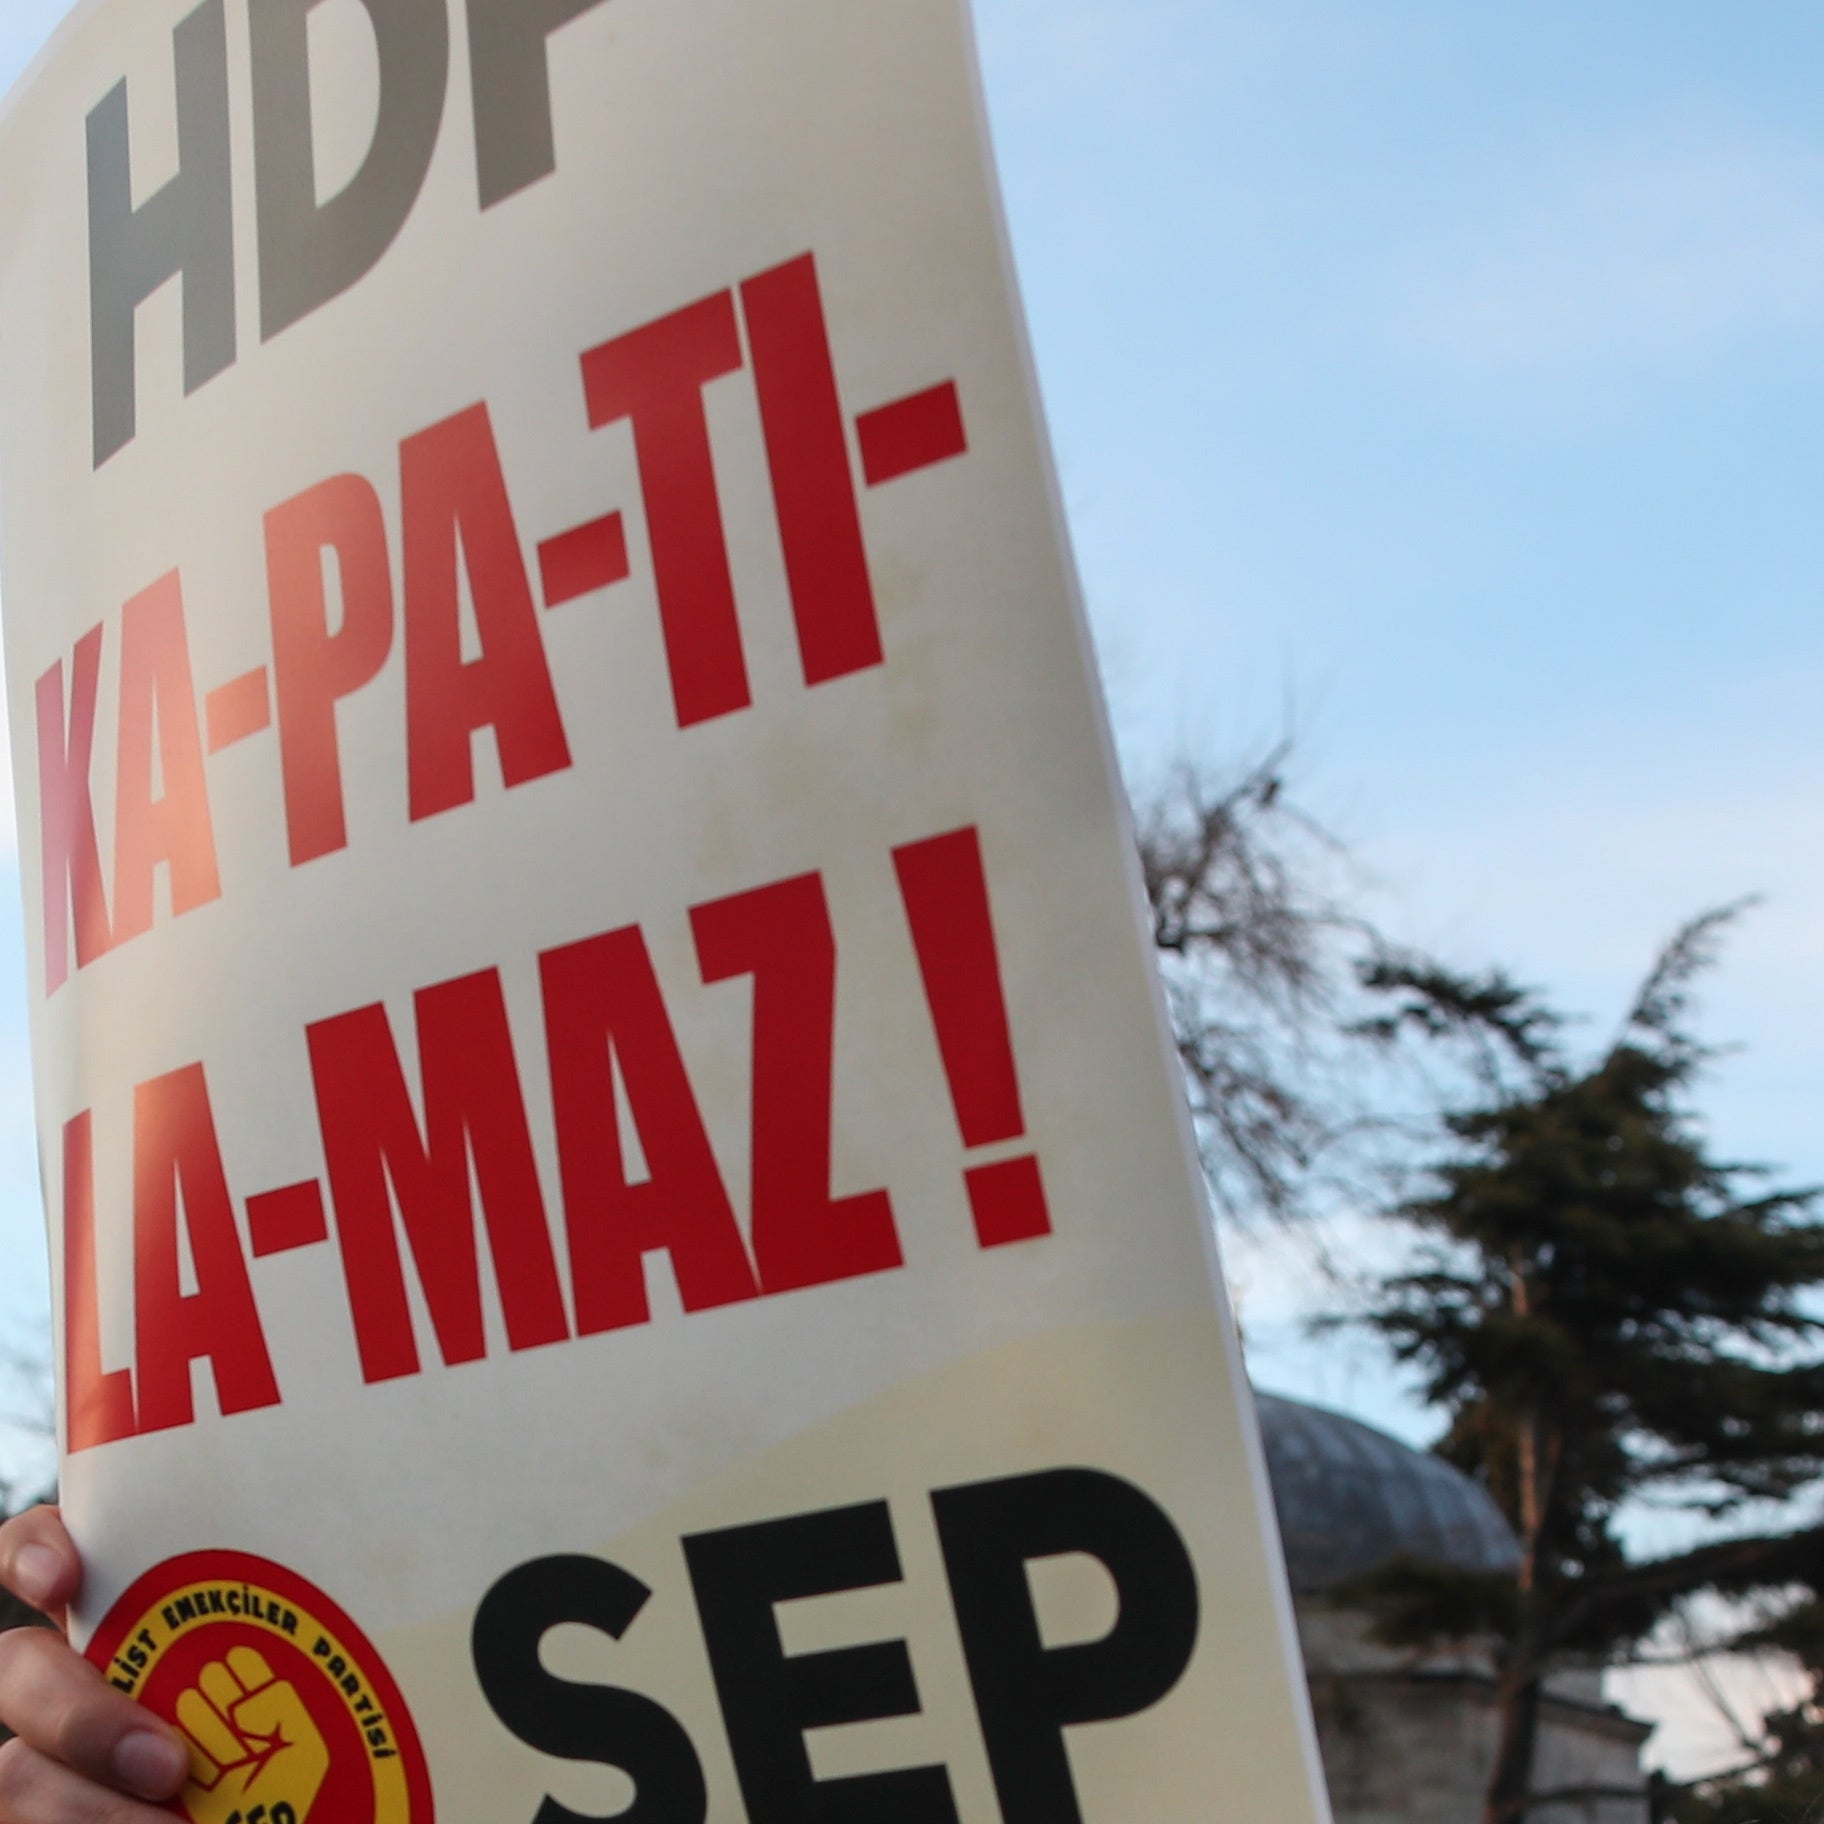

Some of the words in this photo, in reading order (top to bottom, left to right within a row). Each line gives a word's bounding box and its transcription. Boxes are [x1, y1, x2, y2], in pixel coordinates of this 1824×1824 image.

[35, 249, 968, 1000] KA-PA-TI-
[161, 1585, 300, 1637] EMEKÇİLER
[312, 1636, 398, 1759] PARTİSİ
